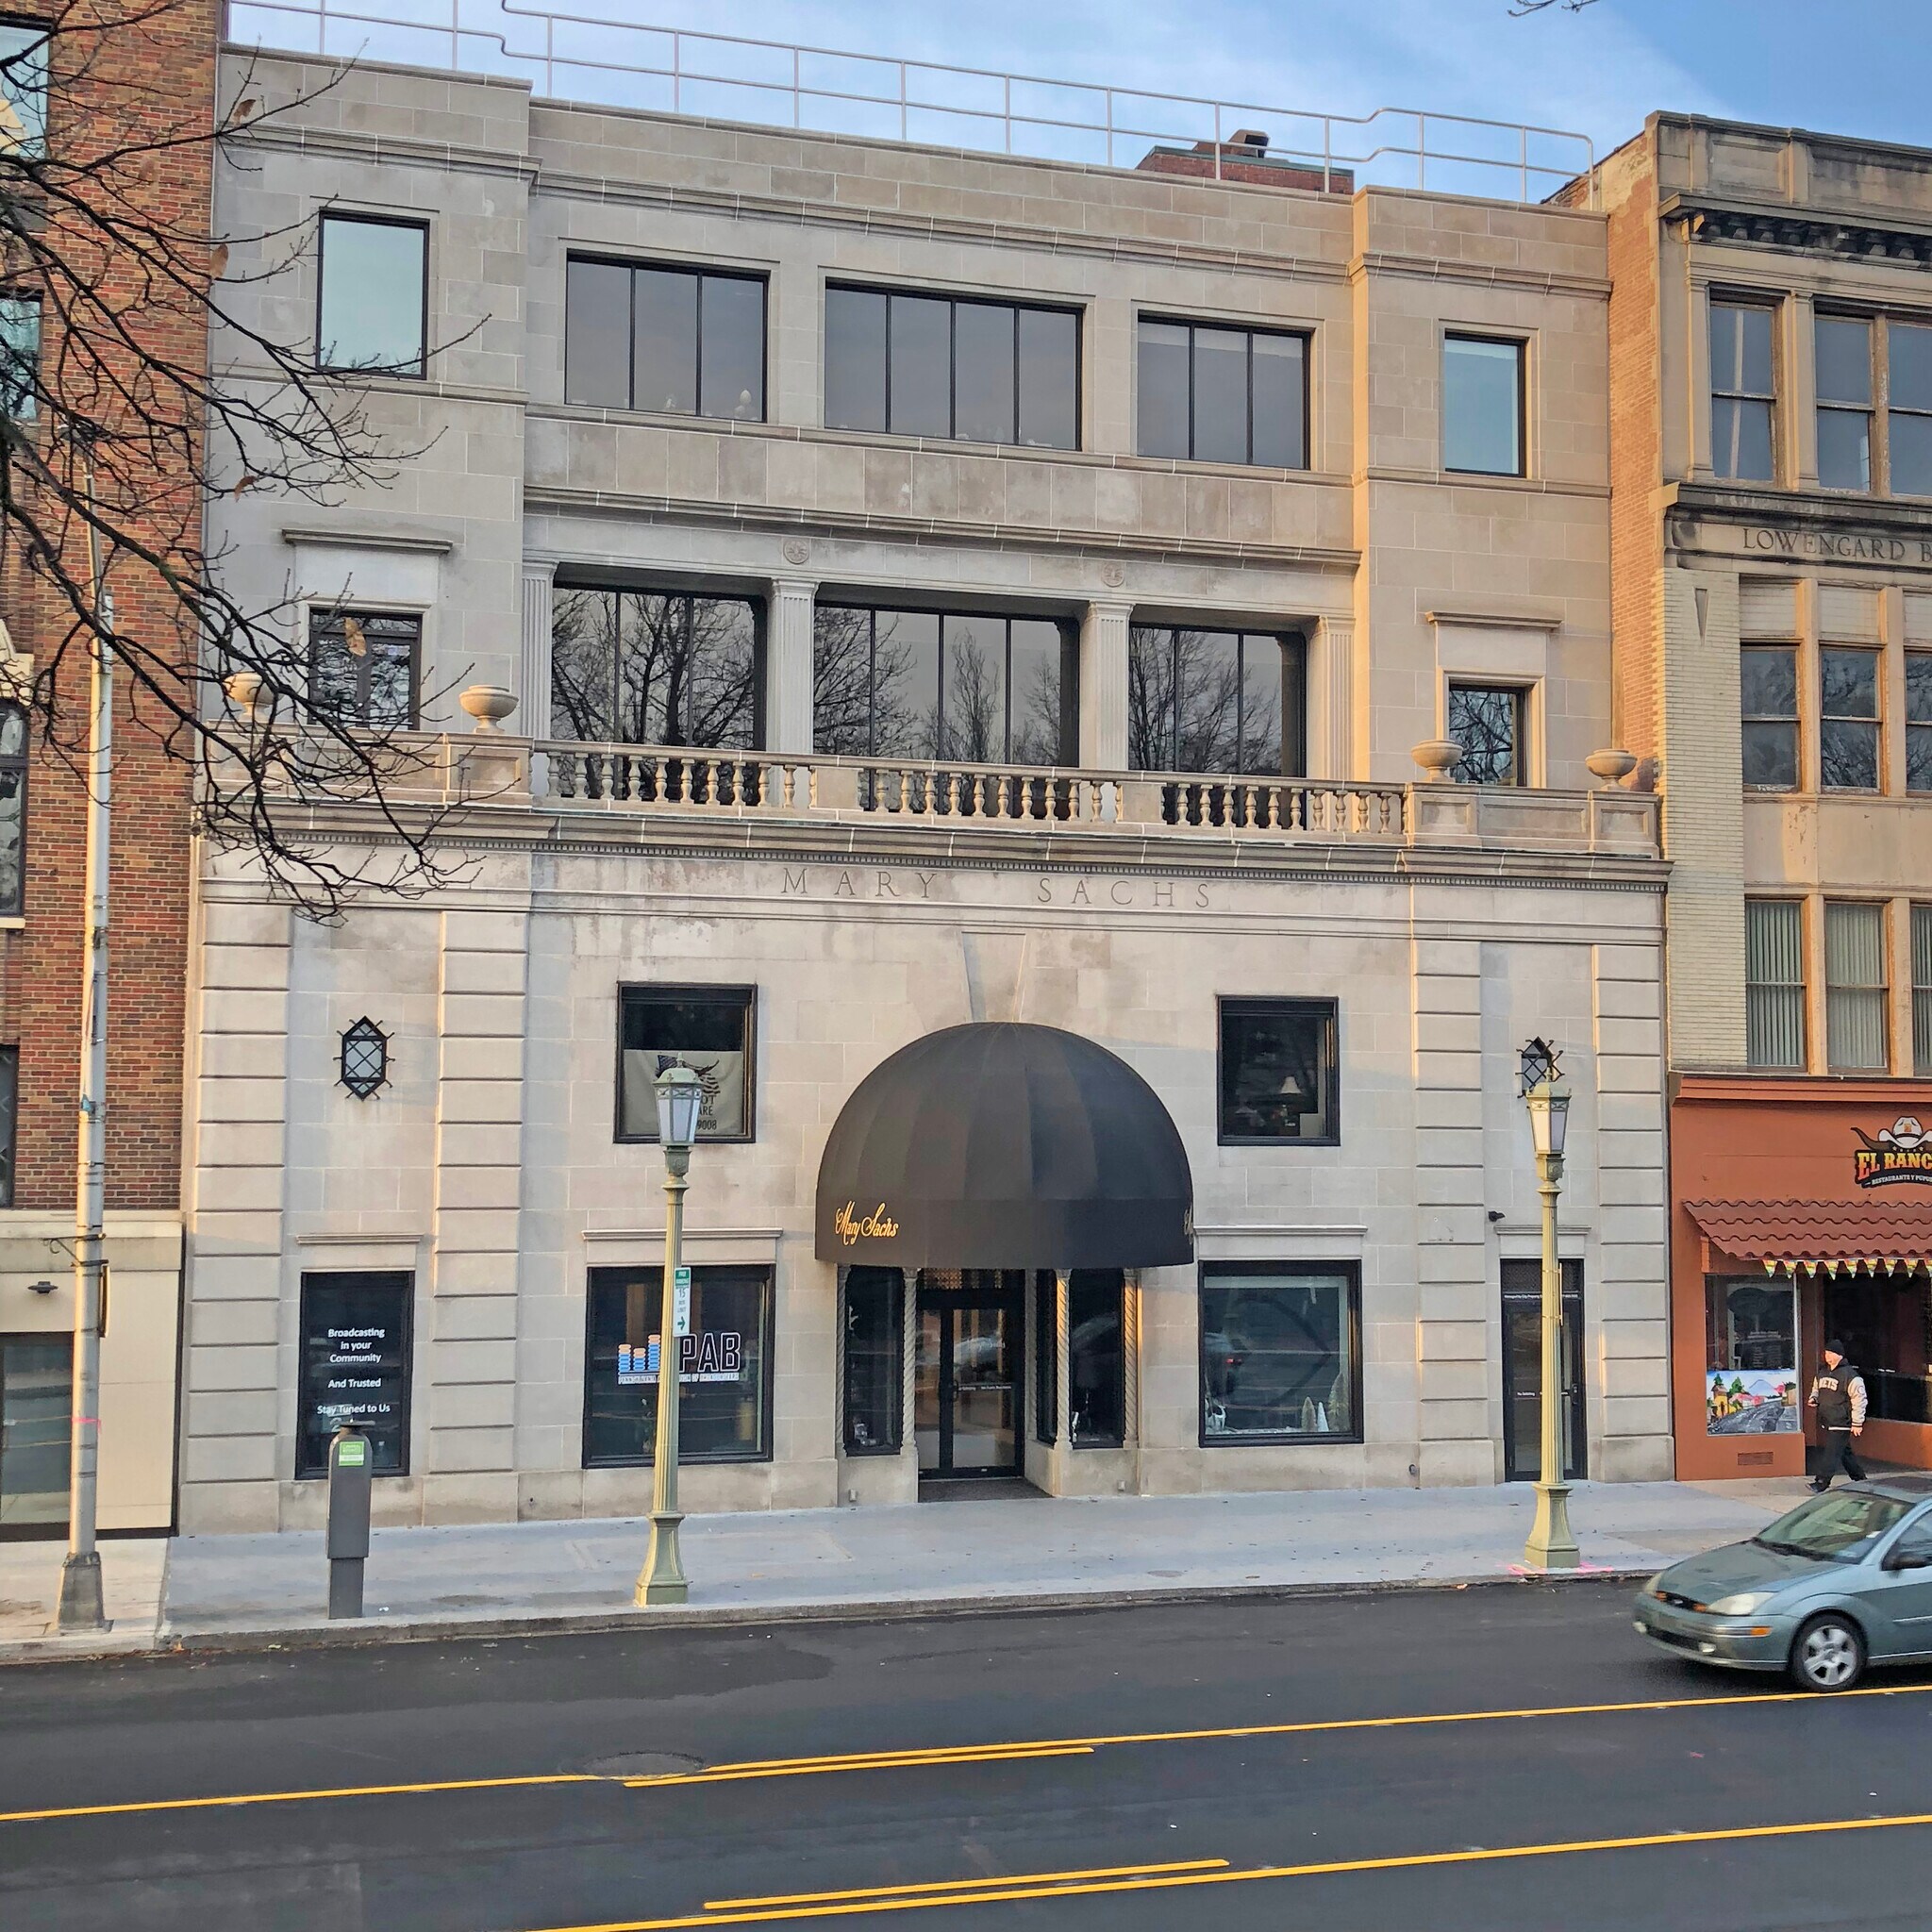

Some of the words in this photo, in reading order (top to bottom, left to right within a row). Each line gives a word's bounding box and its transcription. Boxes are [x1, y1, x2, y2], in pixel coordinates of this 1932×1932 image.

[1742, 527, 1906, 560] LOWENGARD
[780, 867, 938, 899] MARY
[1037, 877, 1210, 908] SACHS
[1857, 1153, 1881, 1180] EL
[1872, 1174, 1910, 1185] RESTAURANTE
[835, 1200, 860, 1245] Mary
[860, 1203, 899, 1237] Sachs
[327, 1327, 385, 1339] Broadcasting
[341, 1341, 350, 1350] in
[351, 1341, 372, 1351] your
[329, 1353, 382, 1363] Community
[679, 1332, 741, 1373] PAB
[327, 1379, 346, 1388] And
[348, 1378, 382, 1388] Trusted
[317, 1405, 337, 1415] Stay
[339, 1403, 365, 1414] Tuned
[367, 1404, 377, 1413] to
[378, 1404, 391, 1413] Us
